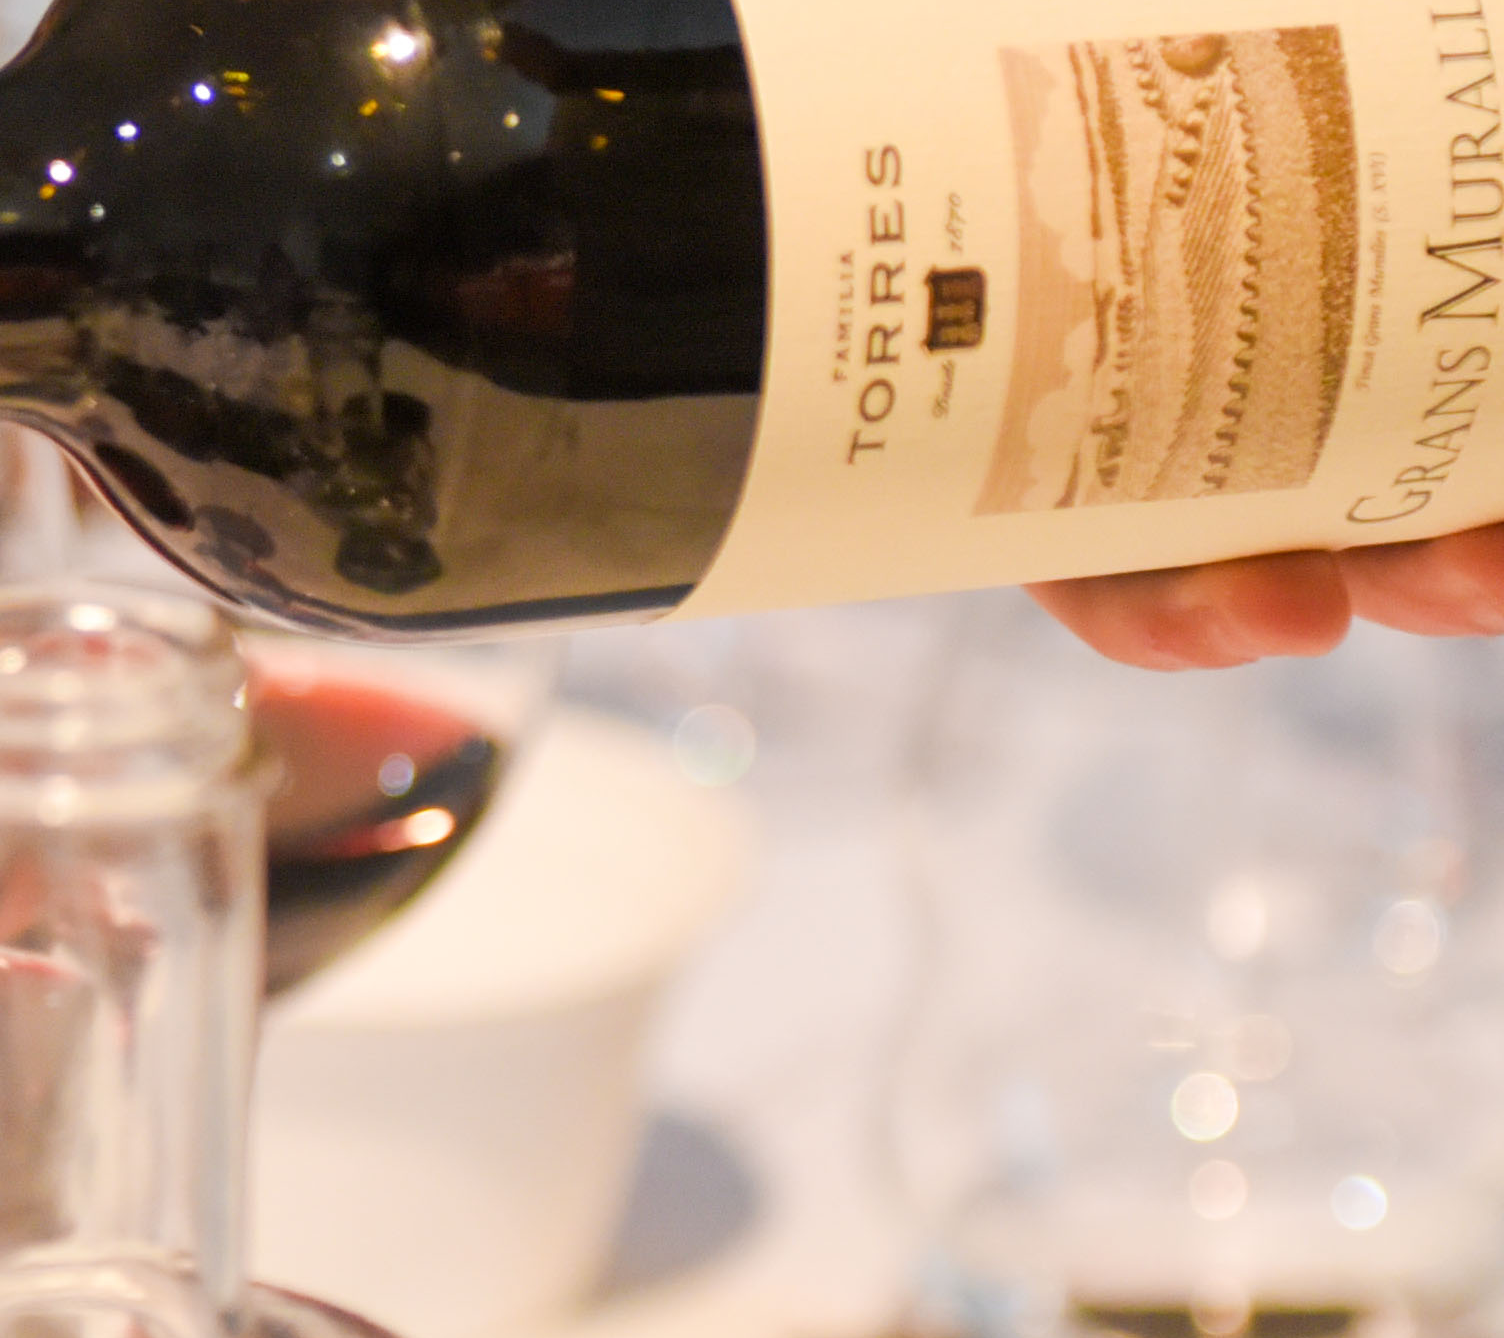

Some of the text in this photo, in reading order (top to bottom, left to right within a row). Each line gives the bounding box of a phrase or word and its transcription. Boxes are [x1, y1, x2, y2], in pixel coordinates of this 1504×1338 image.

[832, 250, 855, 383] FAMILIA
[847, 144, 906, 465] TORRES
[1345, 345, 1492, 524] GRANS
